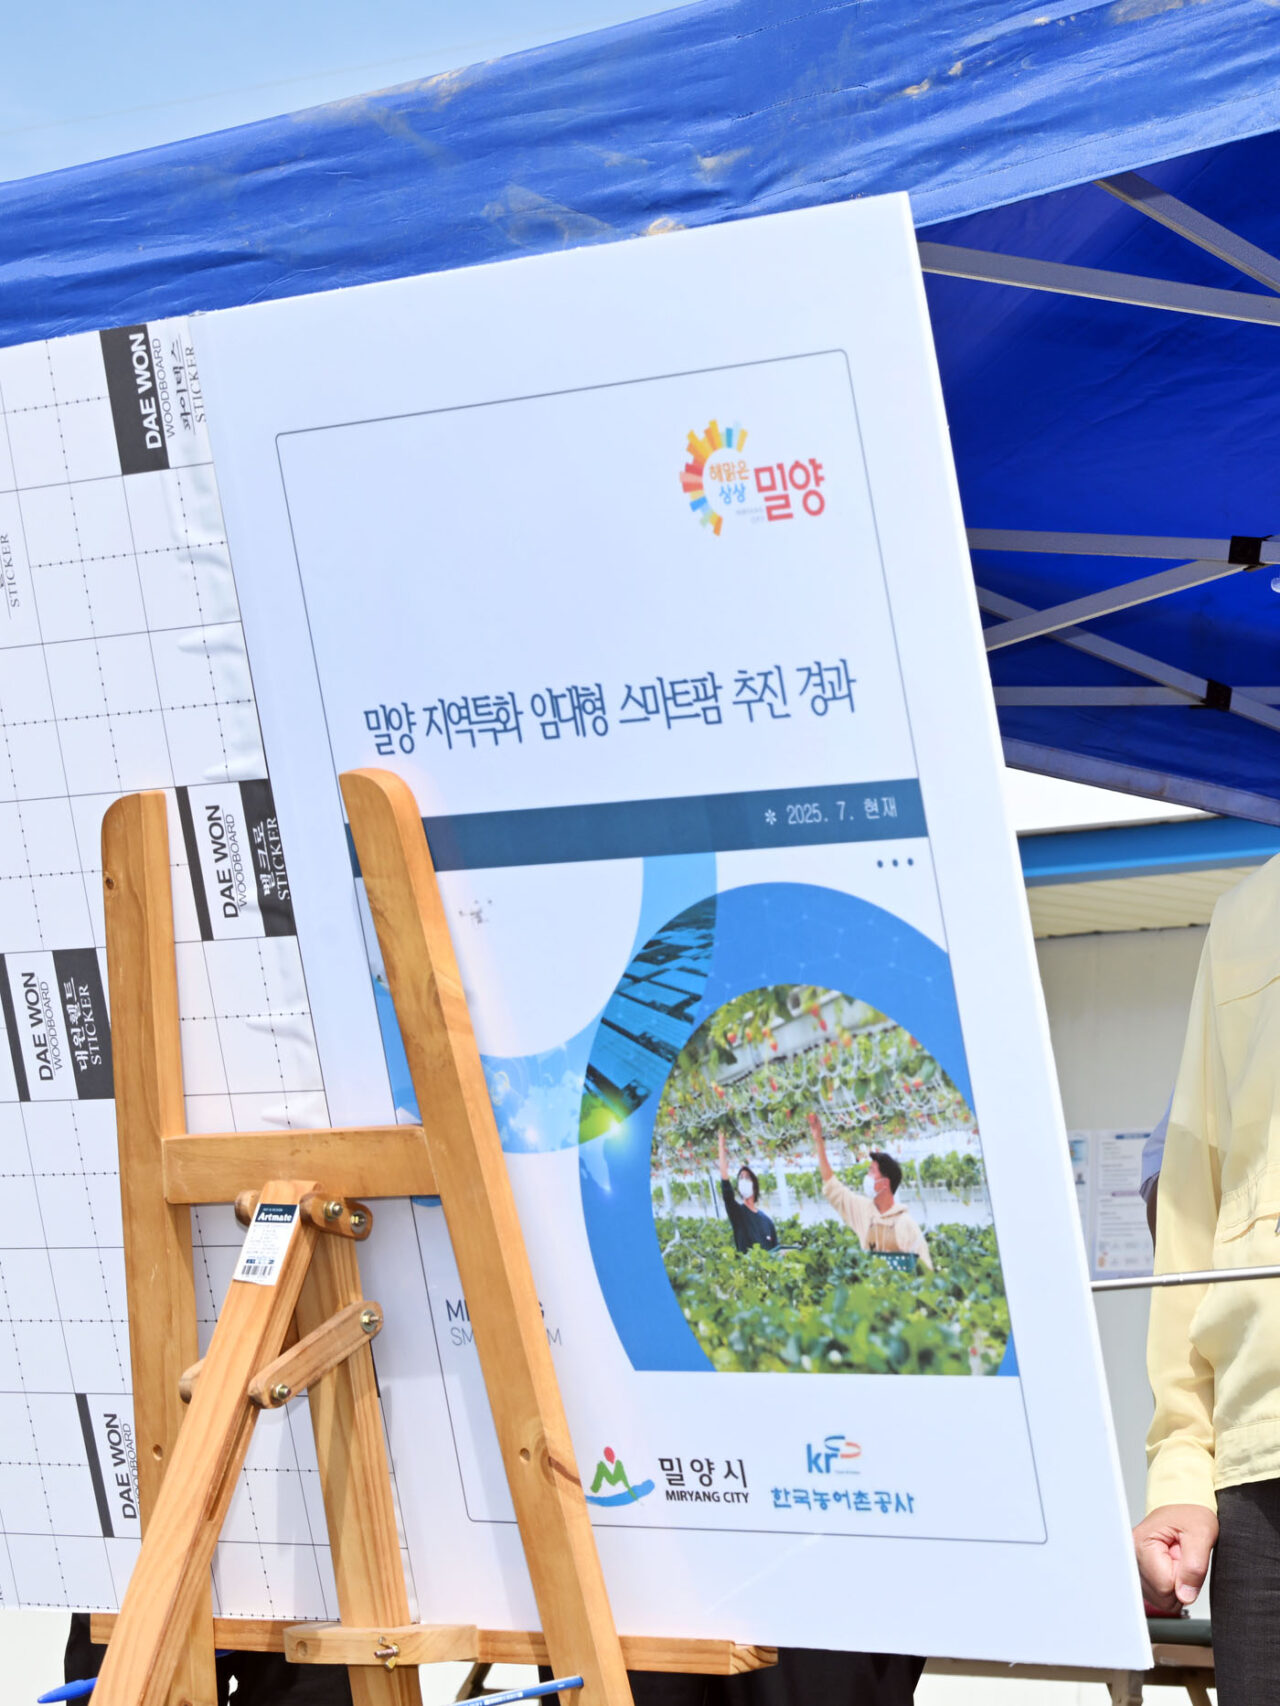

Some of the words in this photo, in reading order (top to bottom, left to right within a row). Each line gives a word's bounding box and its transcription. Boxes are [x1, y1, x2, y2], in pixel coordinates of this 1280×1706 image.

[129, 332, 153, 395] WON
[152, 338, 176, 439] WOODBOARD
[139, 397, 162, 449] DAE
[709, 460, 750, 483] 해맑은
[719, 483, 747, 505] 상상
[754, 457, 826, 522] 밀양
[0, 533, 20, 608] STICKER
[363, 702, 417, 756] 밀양
[422, 691, 524, 750] 지역특화
[530, 682, 609, 740] 임대형
[619, 670, 723, 730] 스마트팜
[732, 664, 792, 723] 추진
[796, 658, 857, 717] 경과
[205, 804, 229, 864] WON
[786, 803, 829, 825] 2025.
[863, 796, 898, 820] 현재
[225, 813, 248, 908] WOODBOARD
[266, 816, 291, 901] STICKER
[216, 868, 239, 919] DAE
[21, 972, 44, 1029] WON
[40, 981, 64, 1070] WOODBOARD
[78, 984, 102, 1066] STICKER
[32, 1033, 54, 1081] DAE
[257, 1212, 293, 1223] Artmate
[103, 1413, 126, 1468] WON
[115, 1473, 137, 1520] DAE
[658, 1457, 748, 1489] 밀양시
[665, 1489, 721, 1504] MIRYANG
[723, 1491, 750, 1504] CITY
[770, 1487, 915, 1514] 한국농어촌공사
